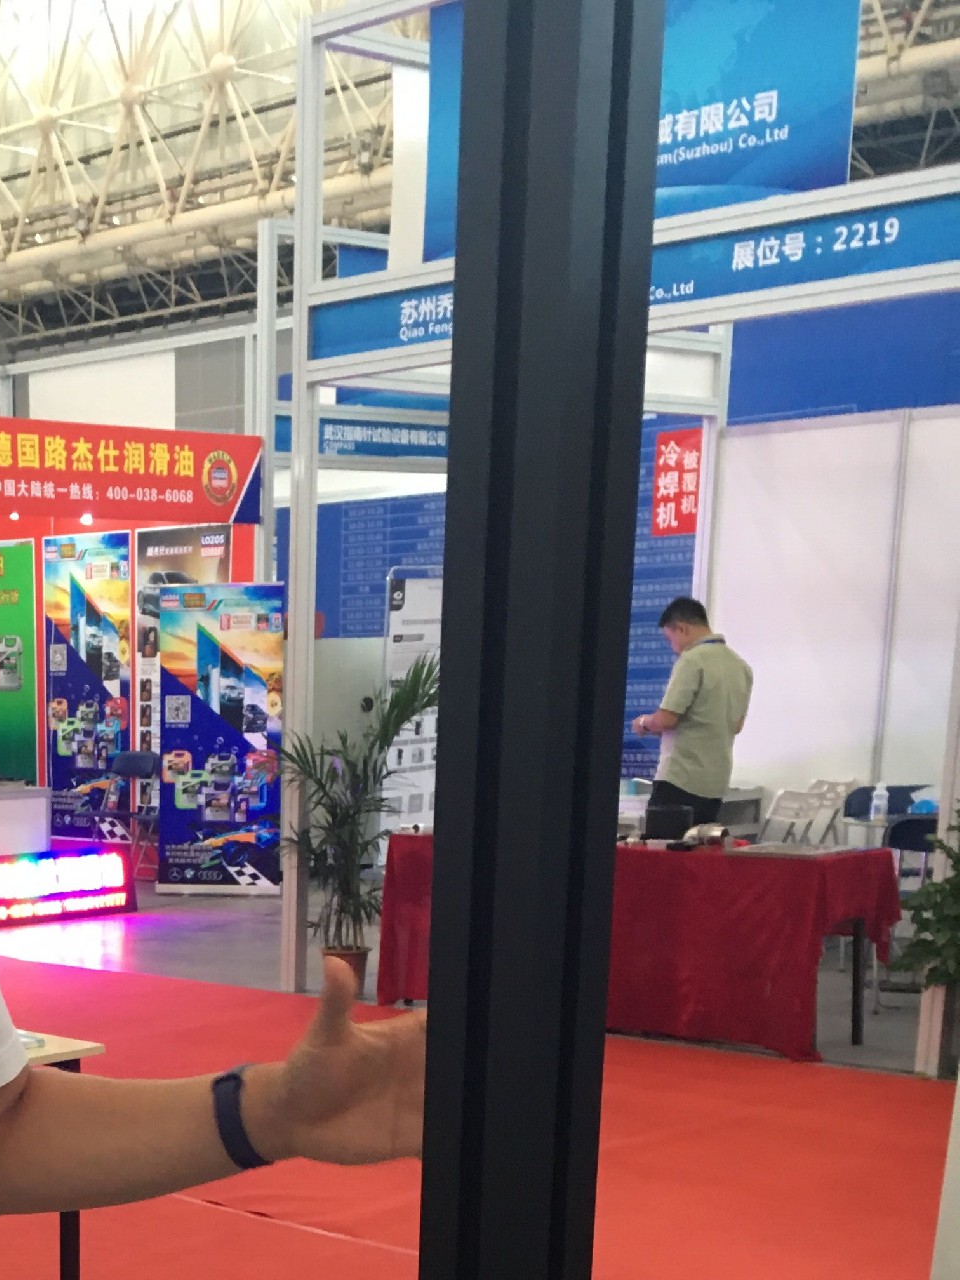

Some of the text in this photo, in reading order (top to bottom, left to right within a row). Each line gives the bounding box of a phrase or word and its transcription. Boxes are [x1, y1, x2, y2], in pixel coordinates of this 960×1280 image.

[400, 325, 425, 341] Qiao
[656, 441, 681, 530] 冷焊机
